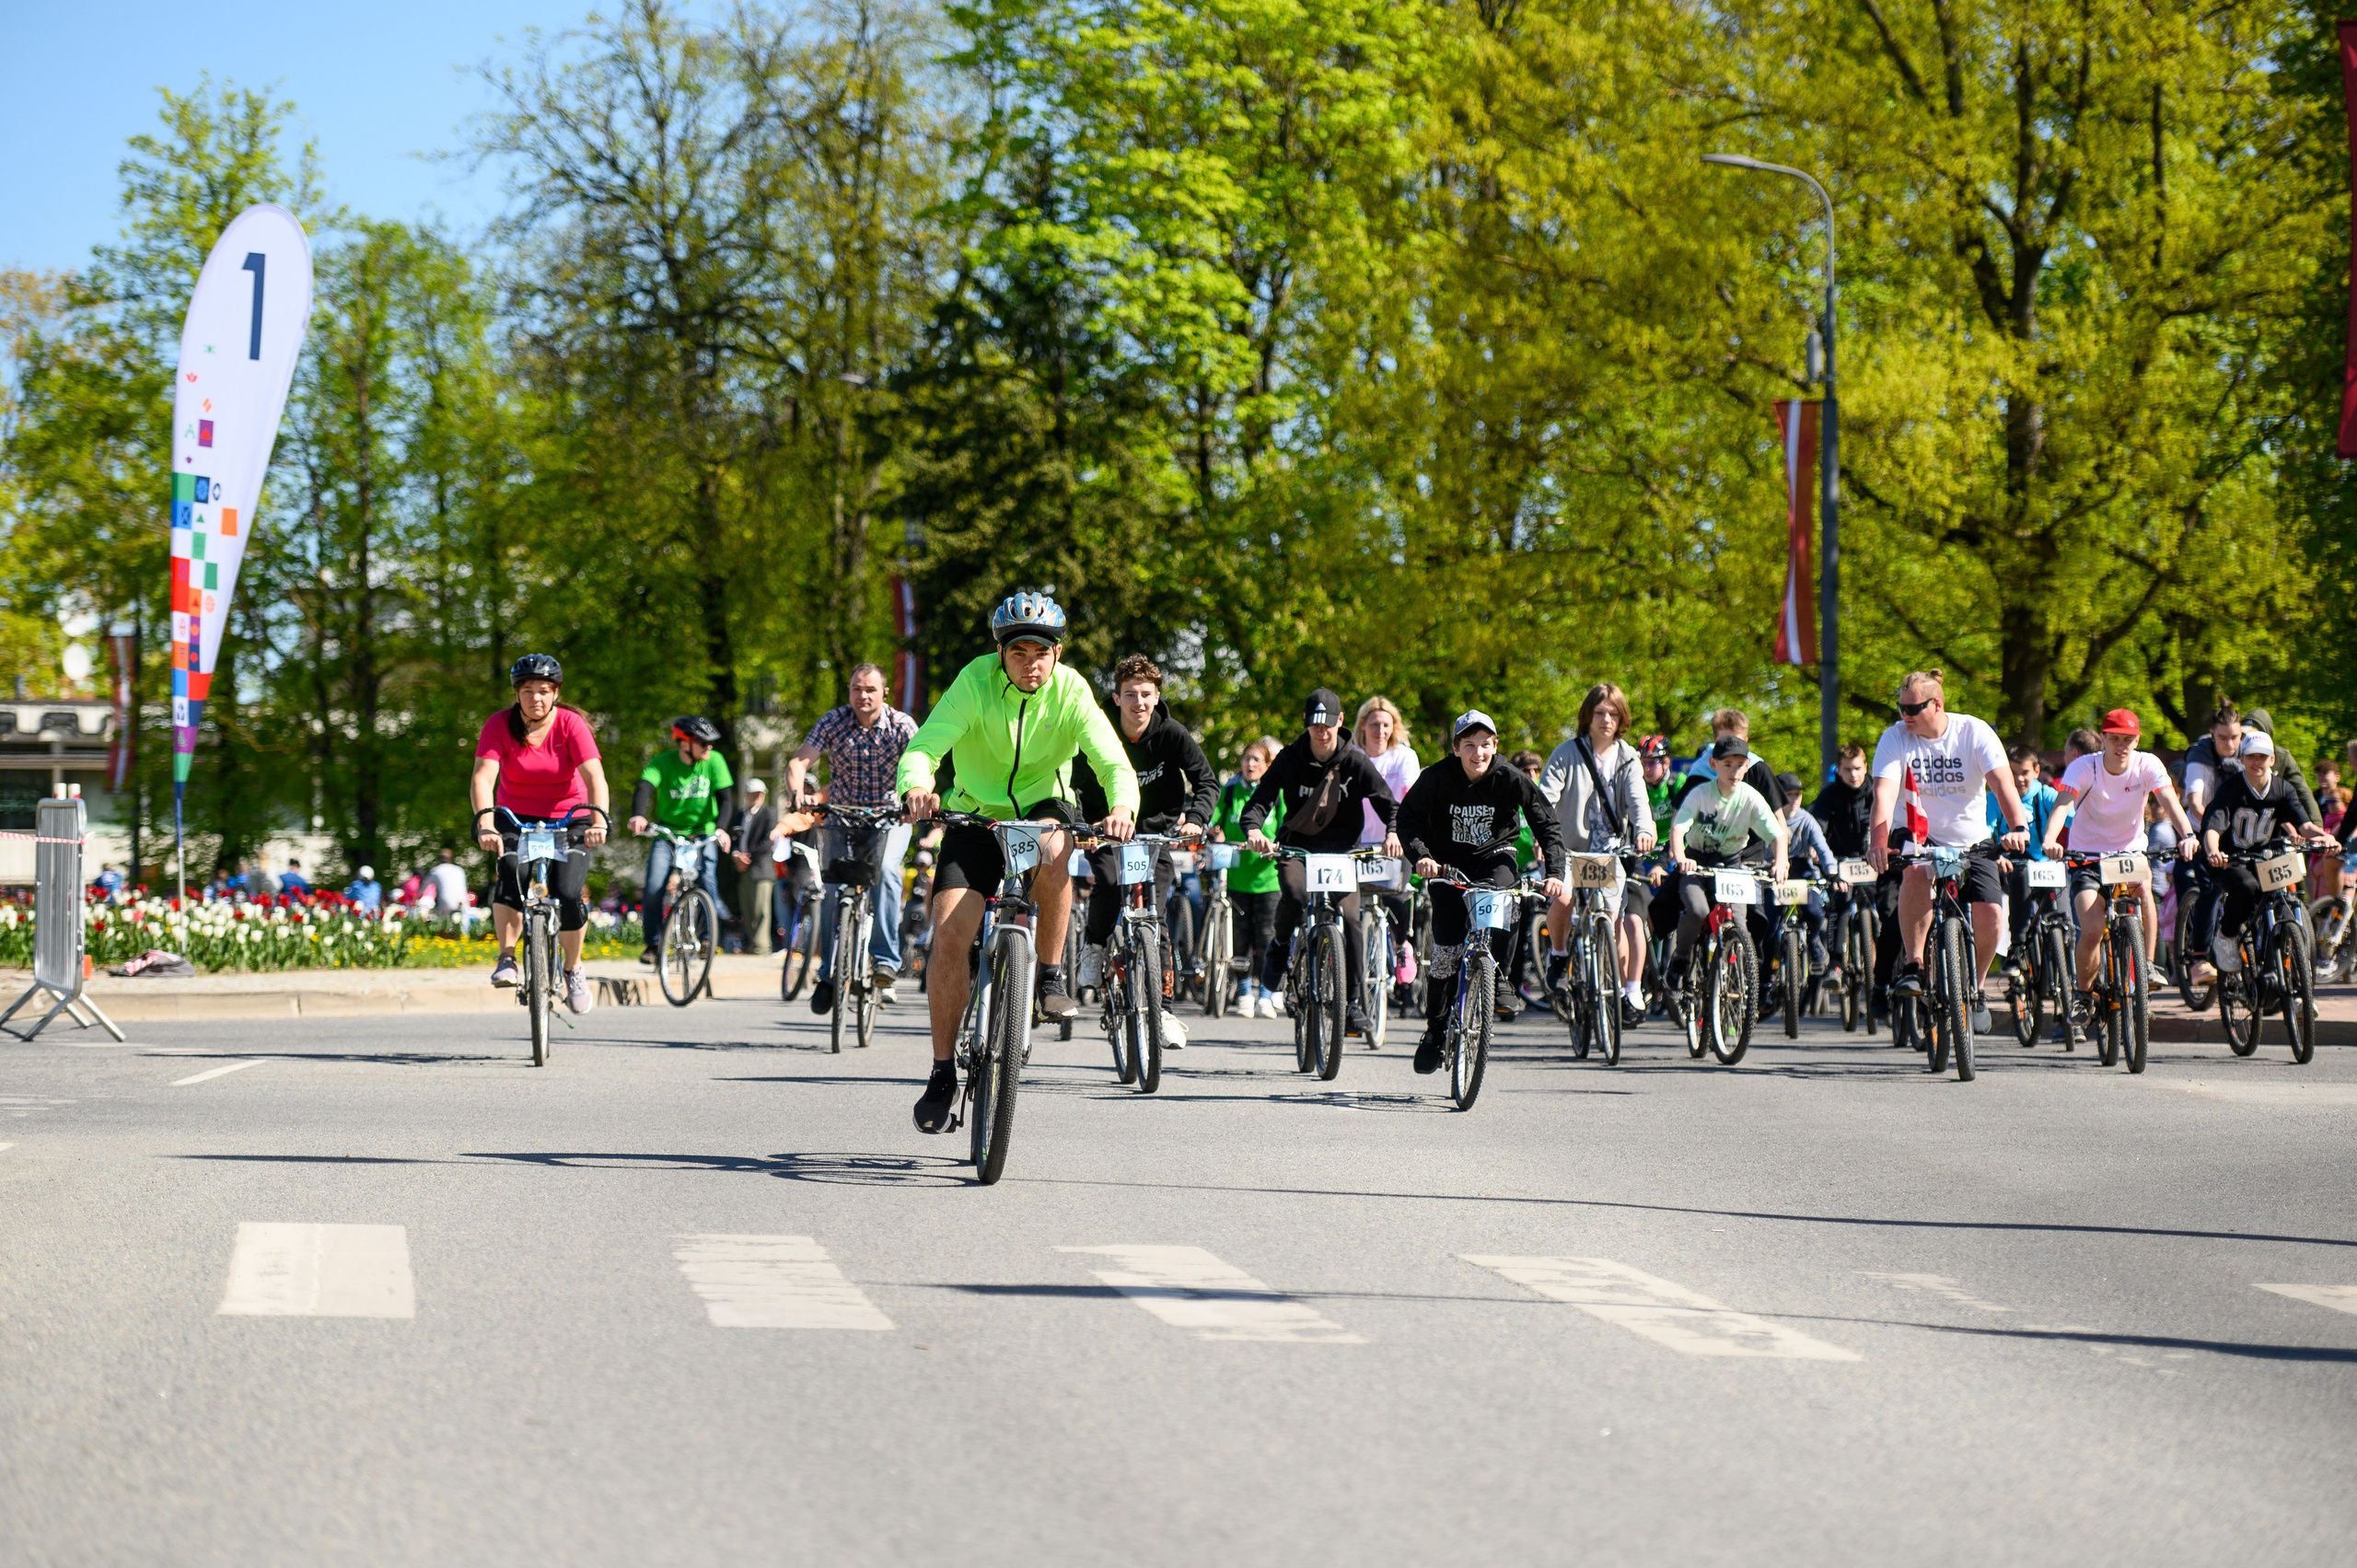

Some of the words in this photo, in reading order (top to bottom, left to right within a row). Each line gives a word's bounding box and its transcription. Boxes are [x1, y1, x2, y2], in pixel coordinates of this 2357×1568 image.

[241, 251, 265, 360] 1
[1911, 755, 1962, 769] adidas
[1912, 770, 1965, 783] addas
[1454, 805, 1495, 818] PAUSED
[2232, 807, 2277, 849] 04
[1011, 841, 1035, 856] 585
[1127, 861, 1147, 871] 505
[1361, 860, 1384, 876] 165
[1583, 865, 1607, 880] 133
[2119, 859, 2134, 874] 19
[1317, 867, 1343, 884] 174
[2033, 870, 2054, 881] 165
[2268, 864, 2293, 884] 135
[1721, 882, 1744, 897] 165
[1478, 904, 1499, 915] 507
